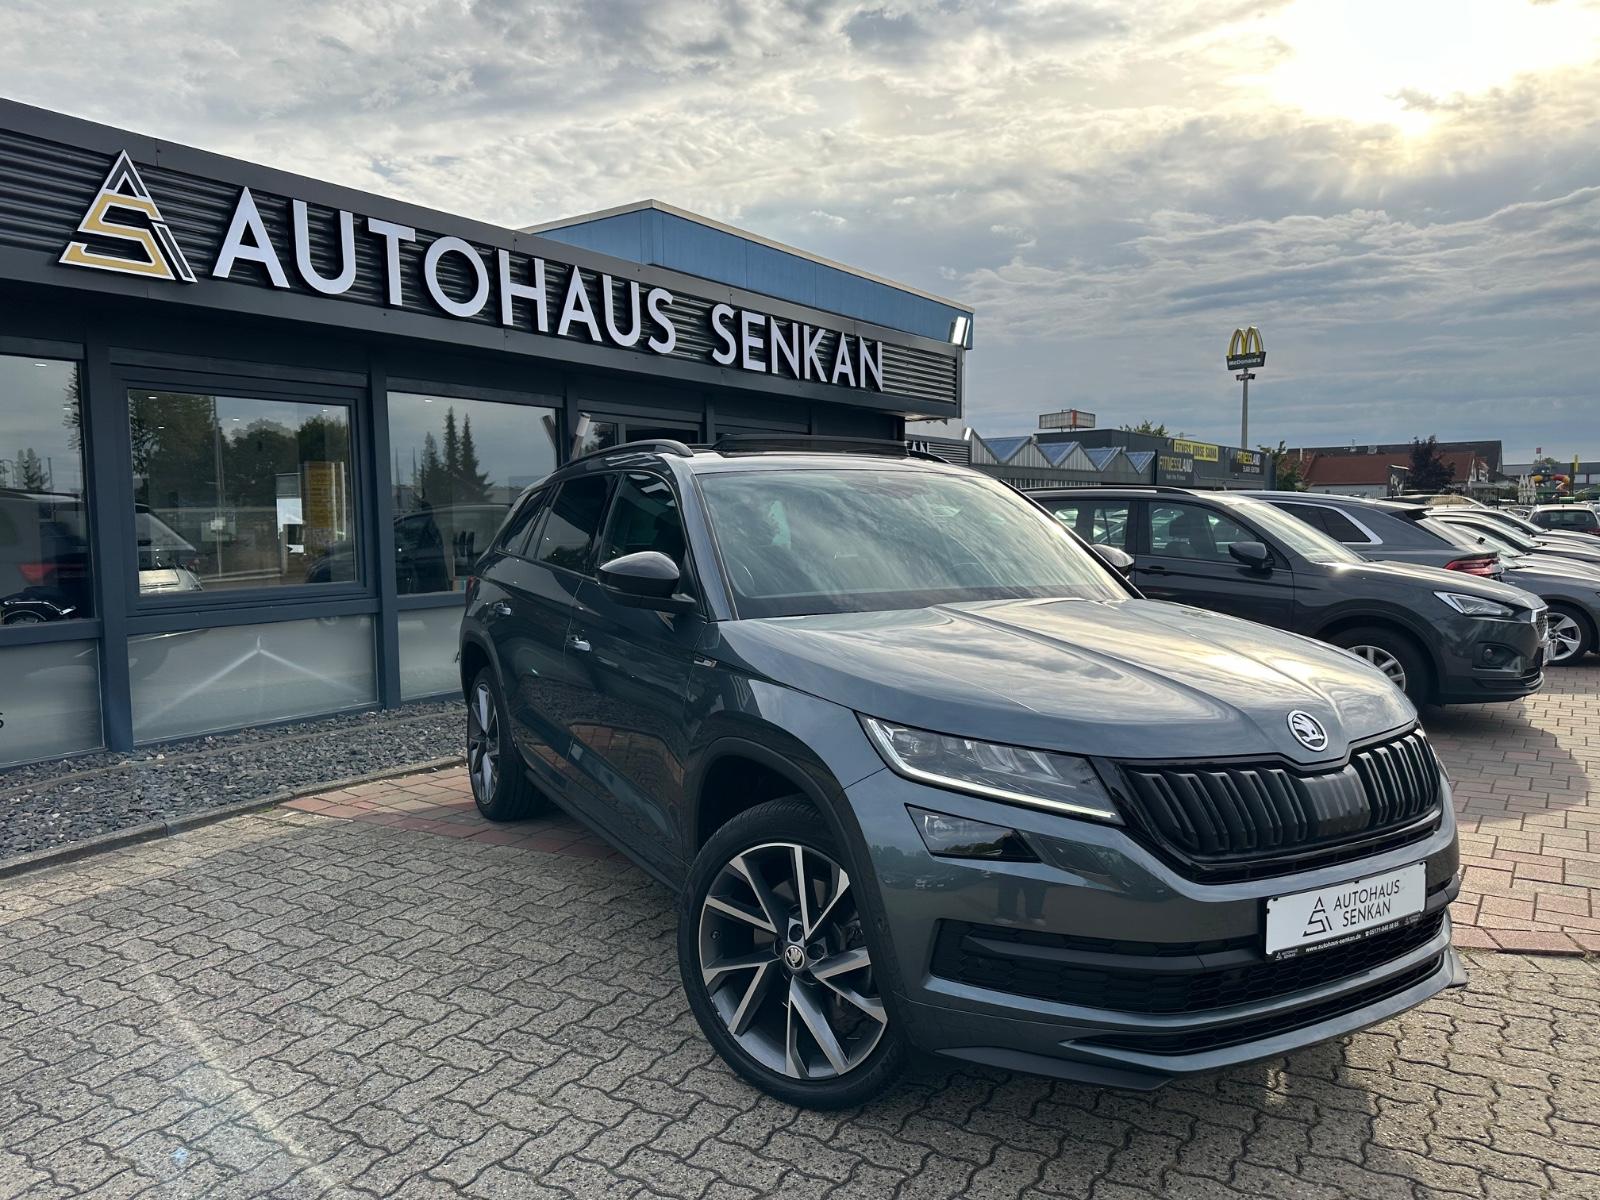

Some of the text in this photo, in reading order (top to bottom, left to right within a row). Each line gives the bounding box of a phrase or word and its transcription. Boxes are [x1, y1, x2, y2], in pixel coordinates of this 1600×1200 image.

[212, 187, 676, 356] AUTOHAUS
[711, 301, 884, 392] SENKAN
[1159, 456, 1193, 473] FITNESSLAND
[1334, 880, 1400, 911] AUTOHAUS
[1342, 898, 1391, 928] SENKAN
